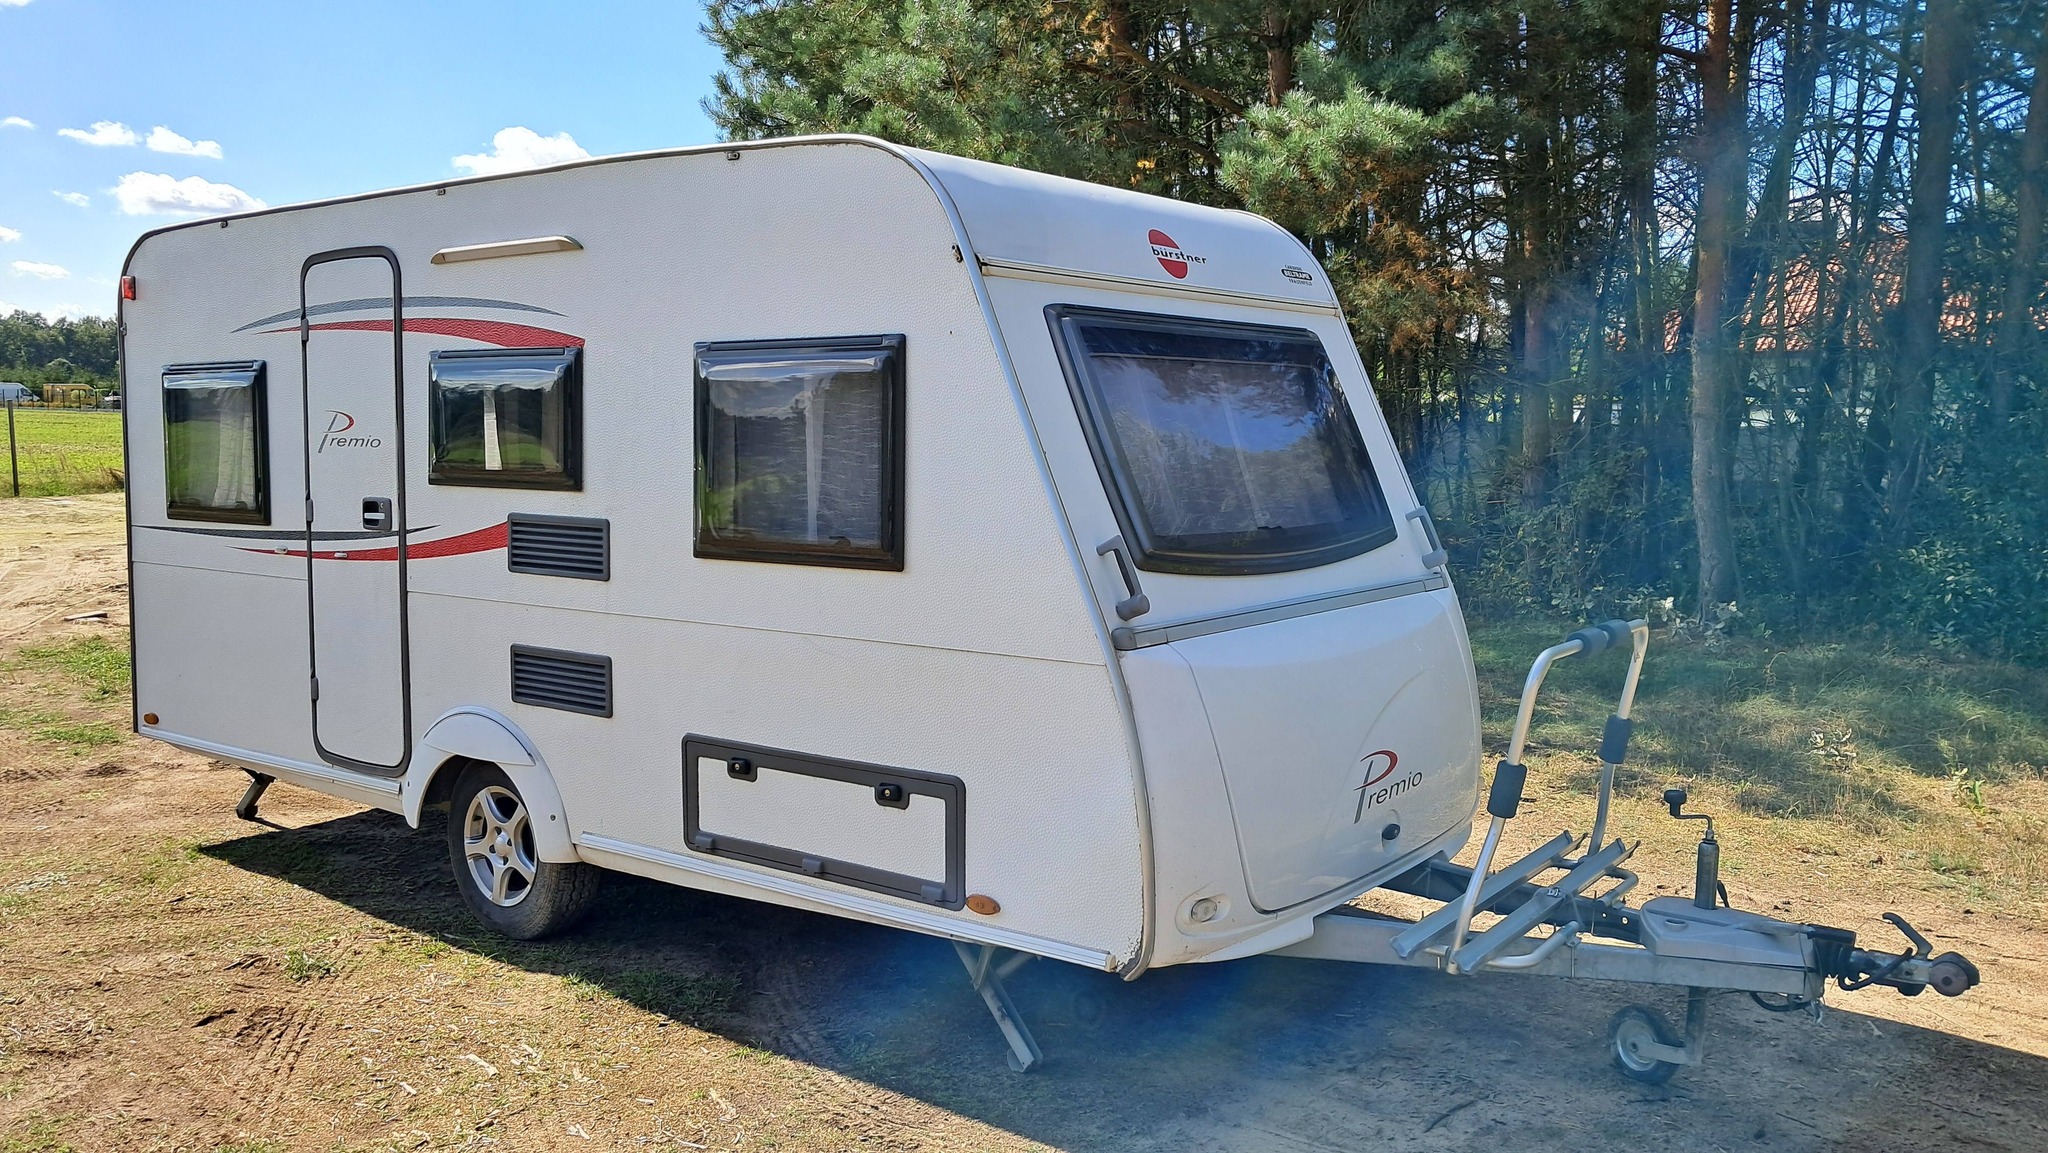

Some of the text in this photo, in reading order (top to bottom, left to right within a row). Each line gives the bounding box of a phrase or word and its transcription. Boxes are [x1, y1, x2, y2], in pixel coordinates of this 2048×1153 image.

[1151, 246, 1207, 264] bürstner
[318, 409, 382, 454] Premio
[1353, 750, 1423, 824] Premio
